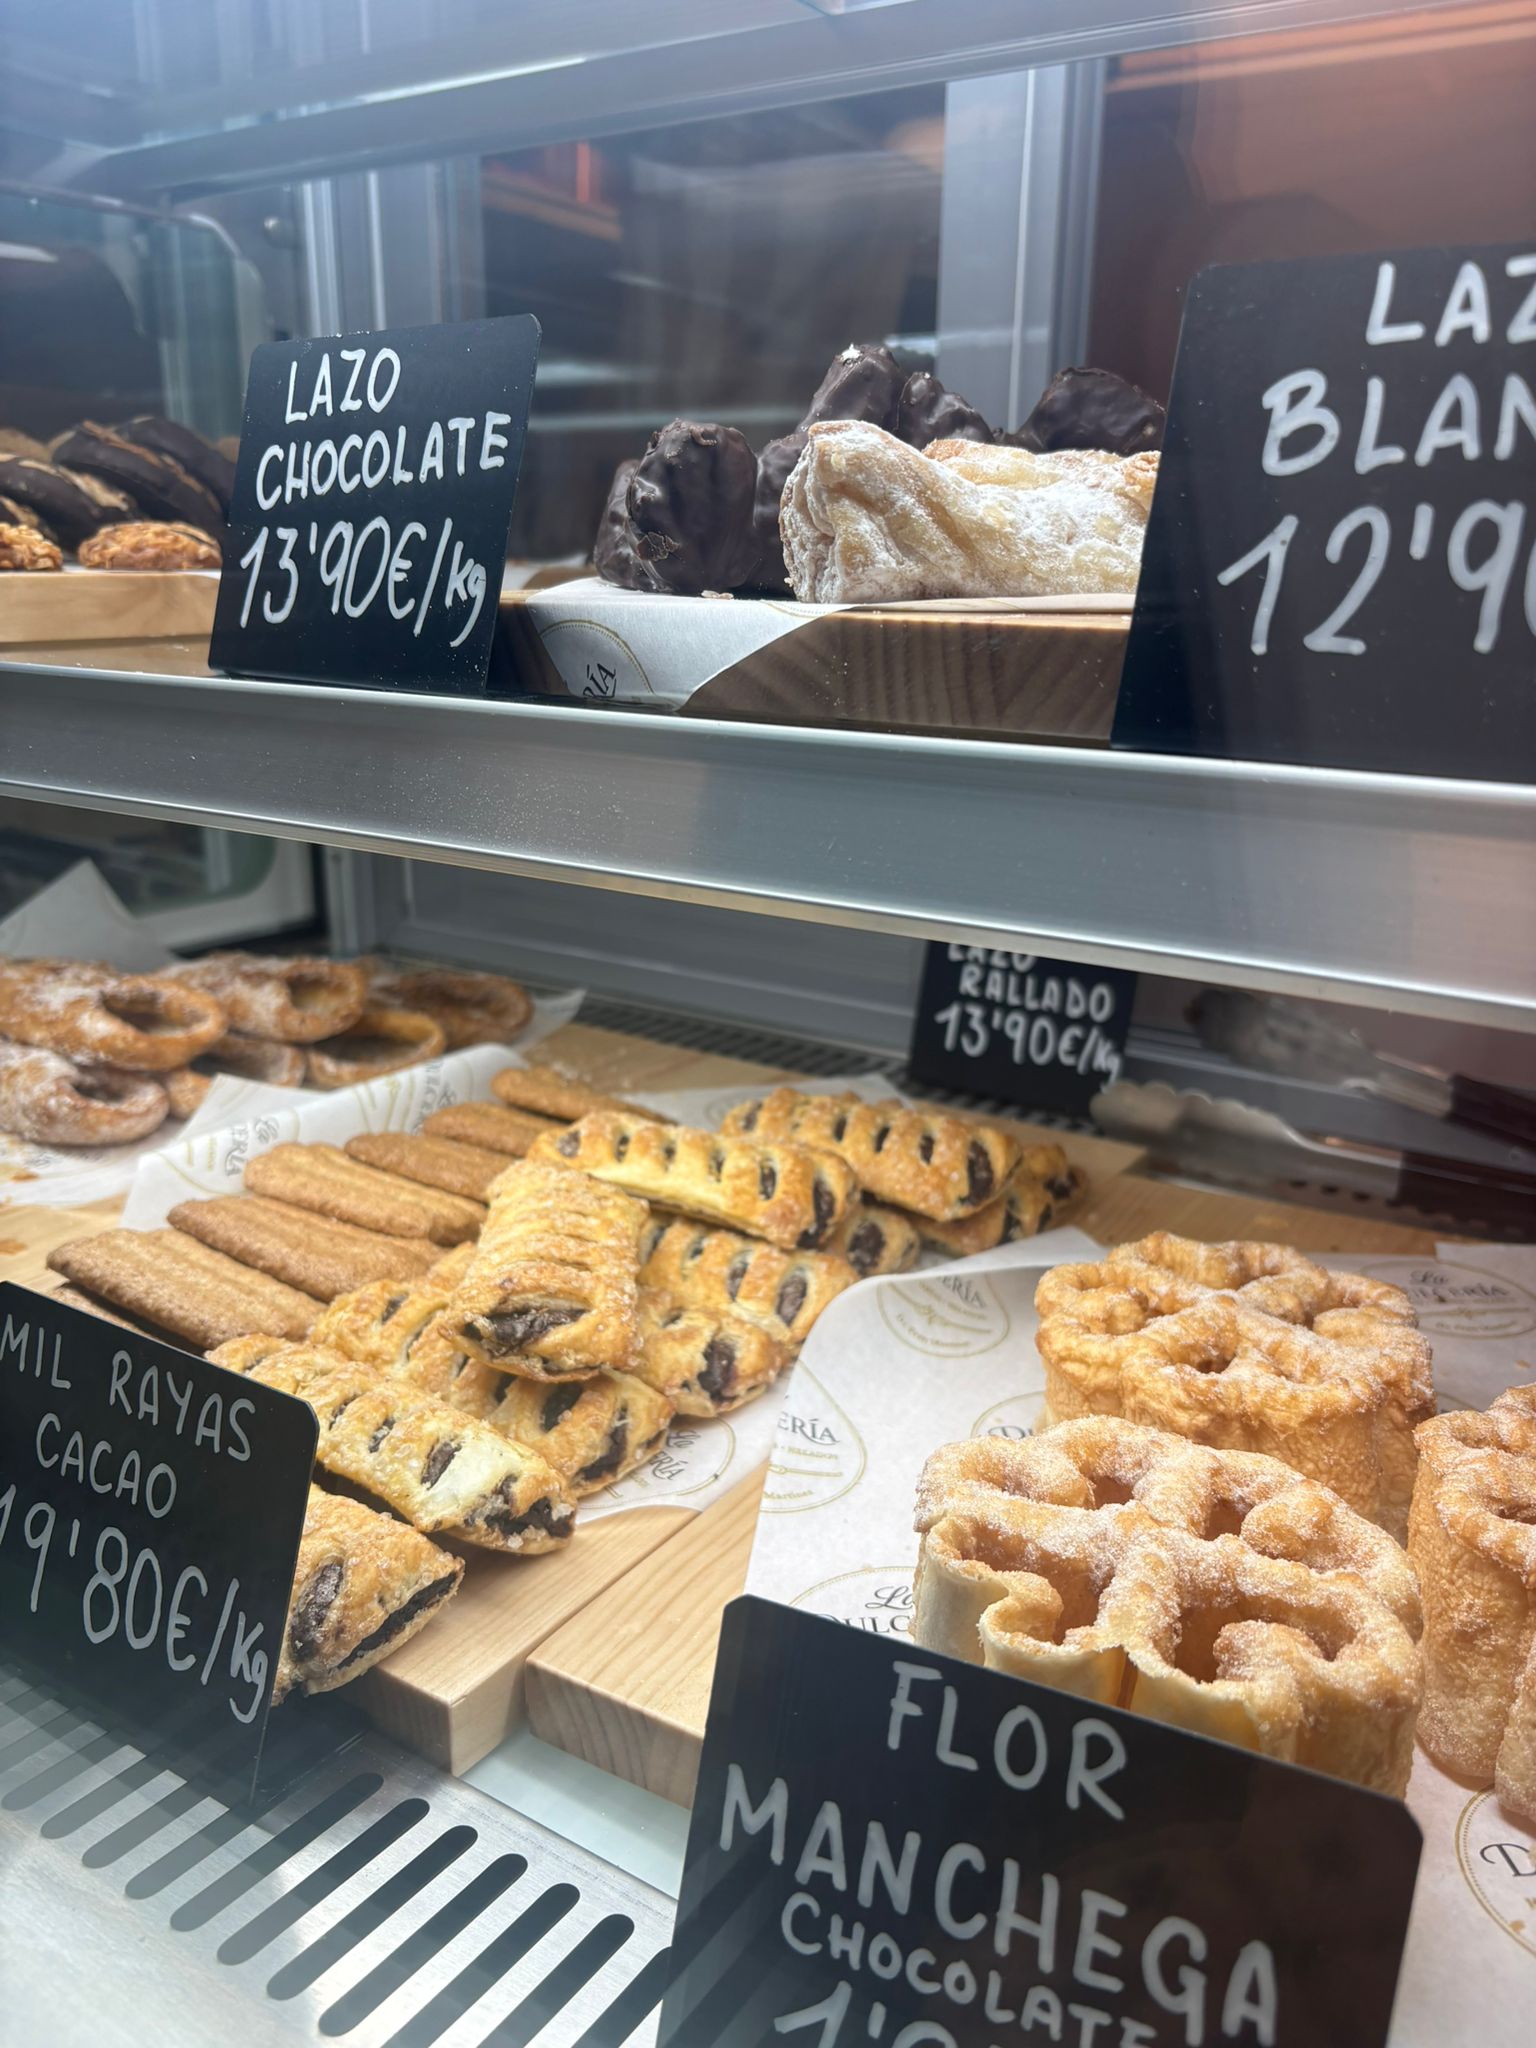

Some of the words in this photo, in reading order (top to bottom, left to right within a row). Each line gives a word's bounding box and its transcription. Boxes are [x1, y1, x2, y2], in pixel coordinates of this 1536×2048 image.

[284, 347, 402, 425] LAZO
[255, 410, 512, 511] CHOCOLATE
[958, 963, 1115, 1024] RALLADO
[0, 1314, 72, 1389] MIL
[109, 1350, 256, 1462] RAYAS
[36, 1412, 177, 1519] CACAO
[887, 1660, 1130, 1821] FLOR
[720, 1763, 1280, 2048] MANCHEGA
